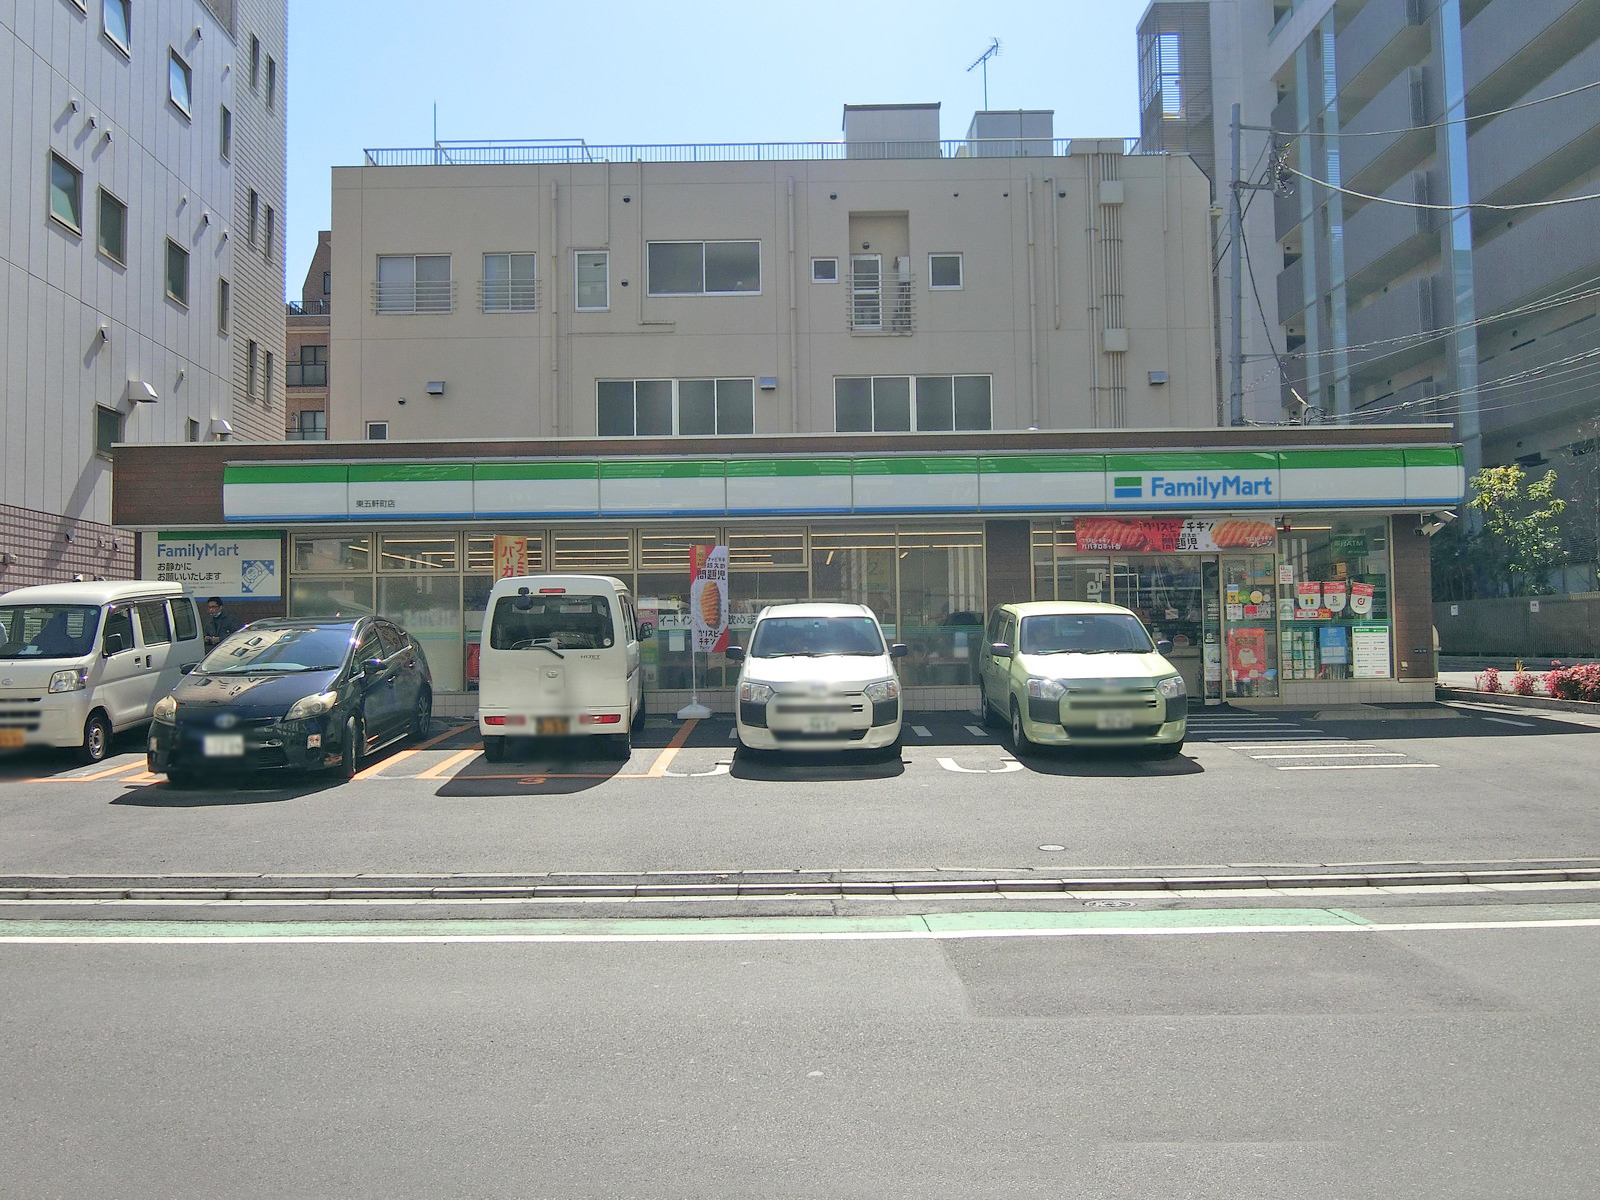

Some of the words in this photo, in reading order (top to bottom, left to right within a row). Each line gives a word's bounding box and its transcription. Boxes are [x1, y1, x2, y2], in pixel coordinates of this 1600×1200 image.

[1151, 475, 1273, 499] FamilyMart
[356, 499, 396, 508] 東五軒町店
[1162, 537, 1199, 550] 問題児
[157, 543, 239, 560] FamilyMart
[514, 541, 525, 577] ファミ
[157, 562, 192, 571] お静かに
[157, 572, 222, 581] お願いいたします
[696, 569, 726, 580] 問題児
[698, 637, 717, 645] チキン
